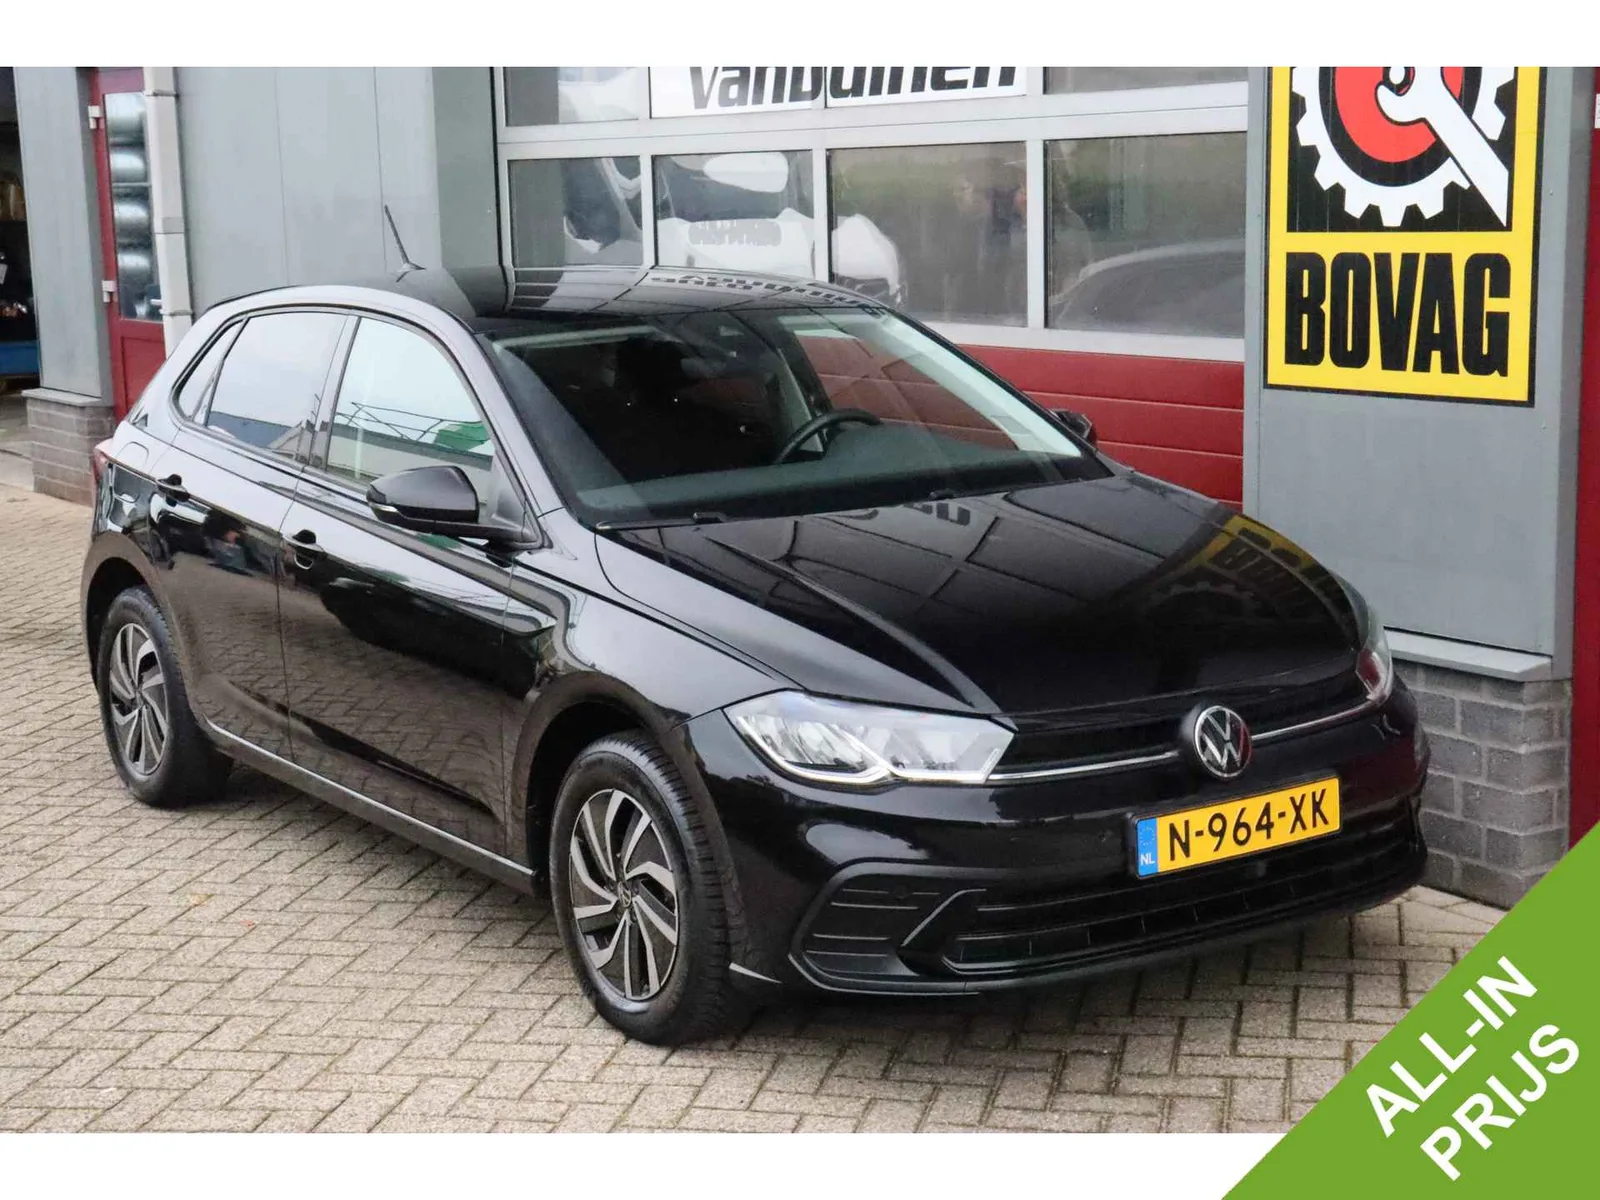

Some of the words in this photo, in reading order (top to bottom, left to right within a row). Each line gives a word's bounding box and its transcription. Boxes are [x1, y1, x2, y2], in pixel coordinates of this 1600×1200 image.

[1284, 252, 1511, 377] BOVAG
[1140, 852, 1156, 866] NL
[1168, 788, 1329, 862] N-964-XK
